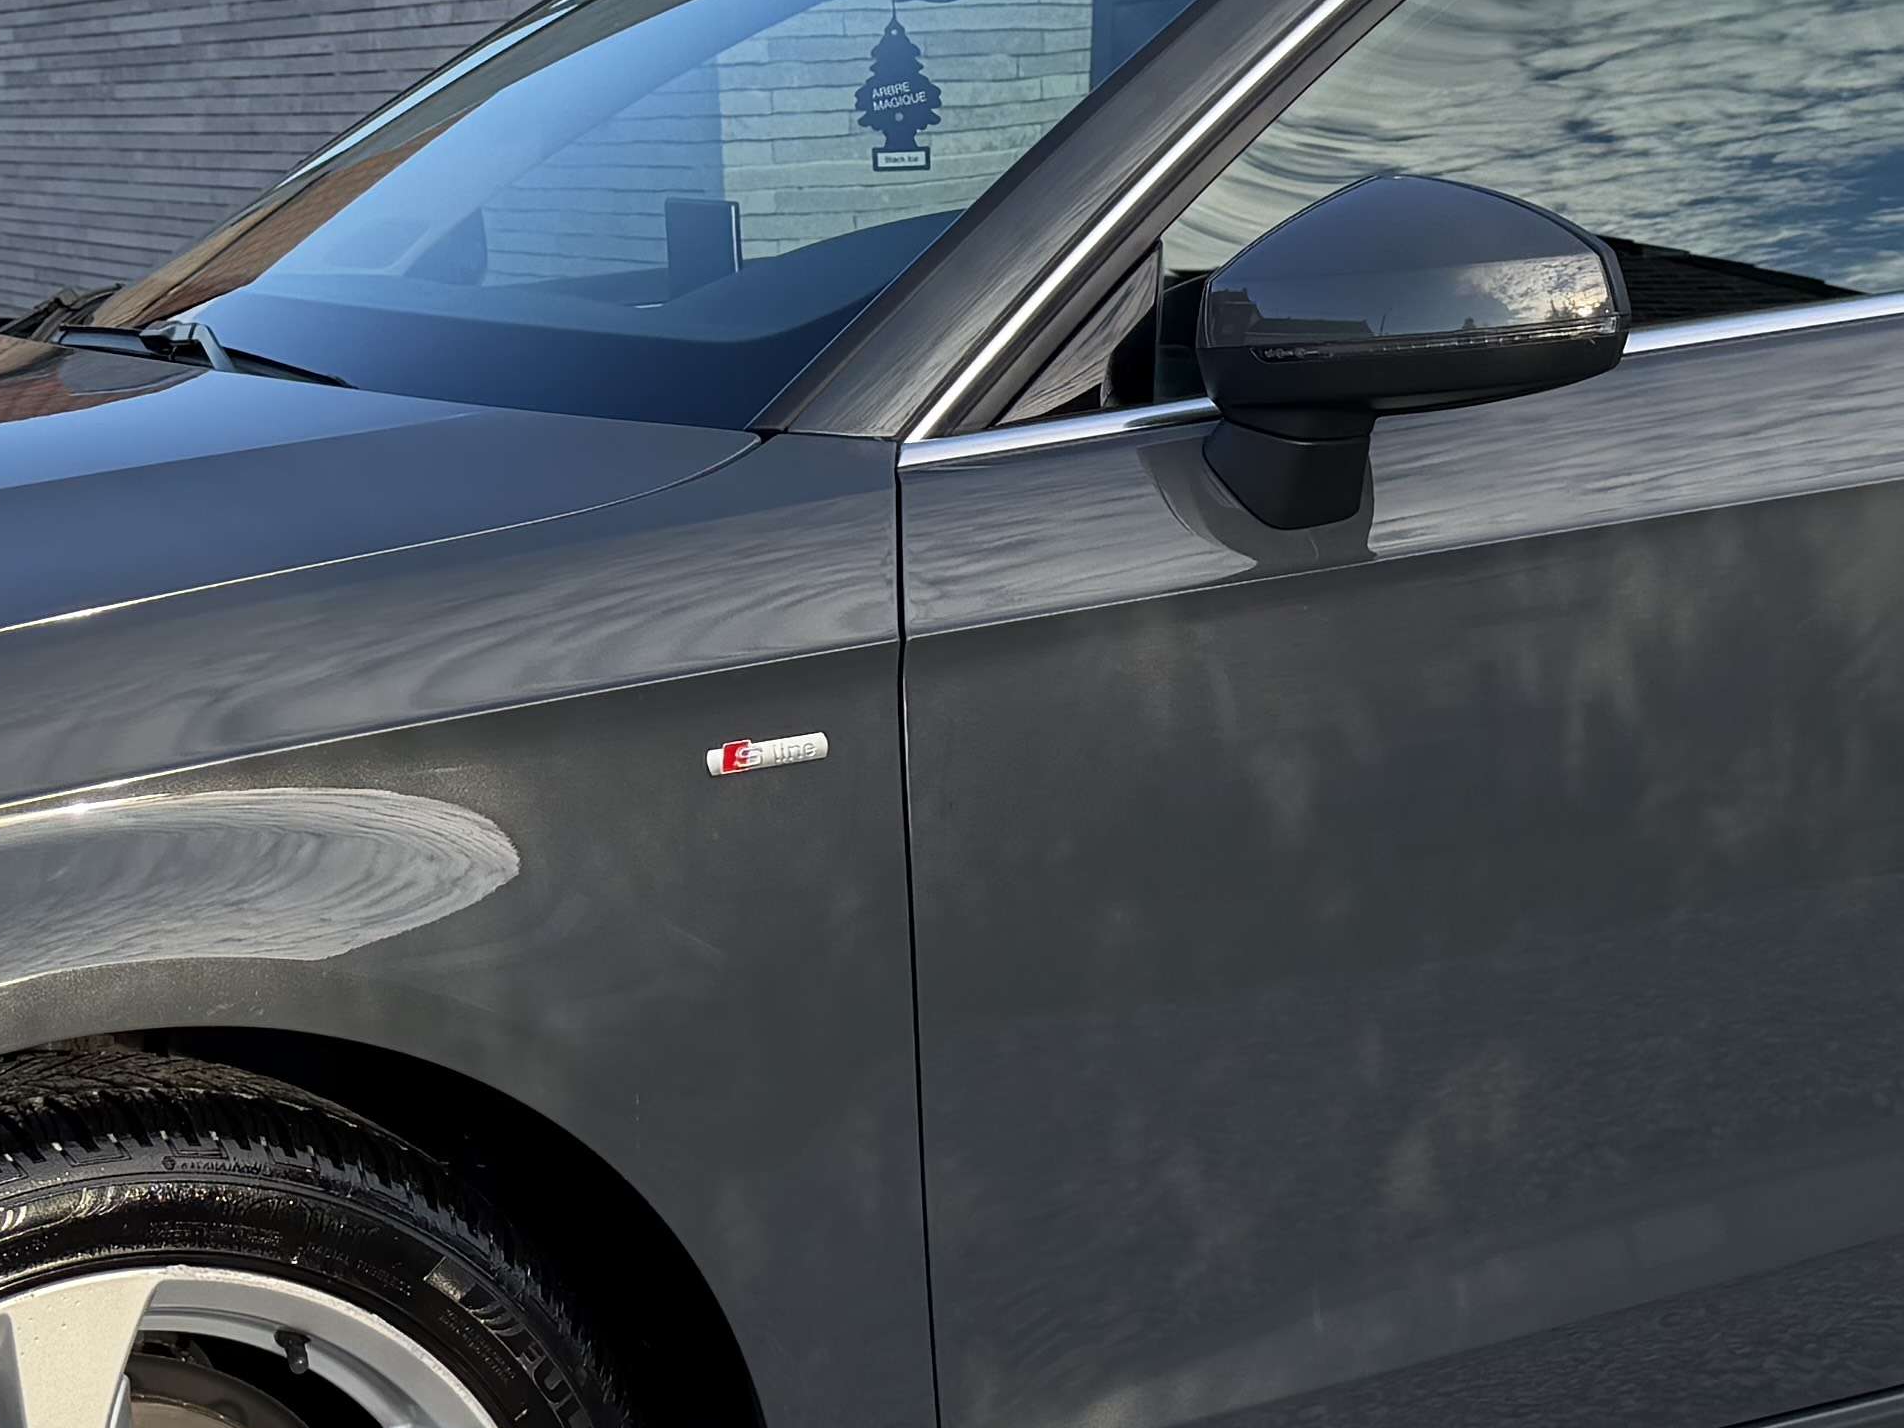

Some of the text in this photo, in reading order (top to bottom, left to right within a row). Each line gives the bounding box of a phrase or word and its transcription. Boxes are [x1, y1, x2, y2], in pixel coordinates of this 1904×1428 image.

[872, 81, 911, 99] ARBRE
[872, 91, 927, 111] MAGIQUE
[735, 740, 818, 768] S line
